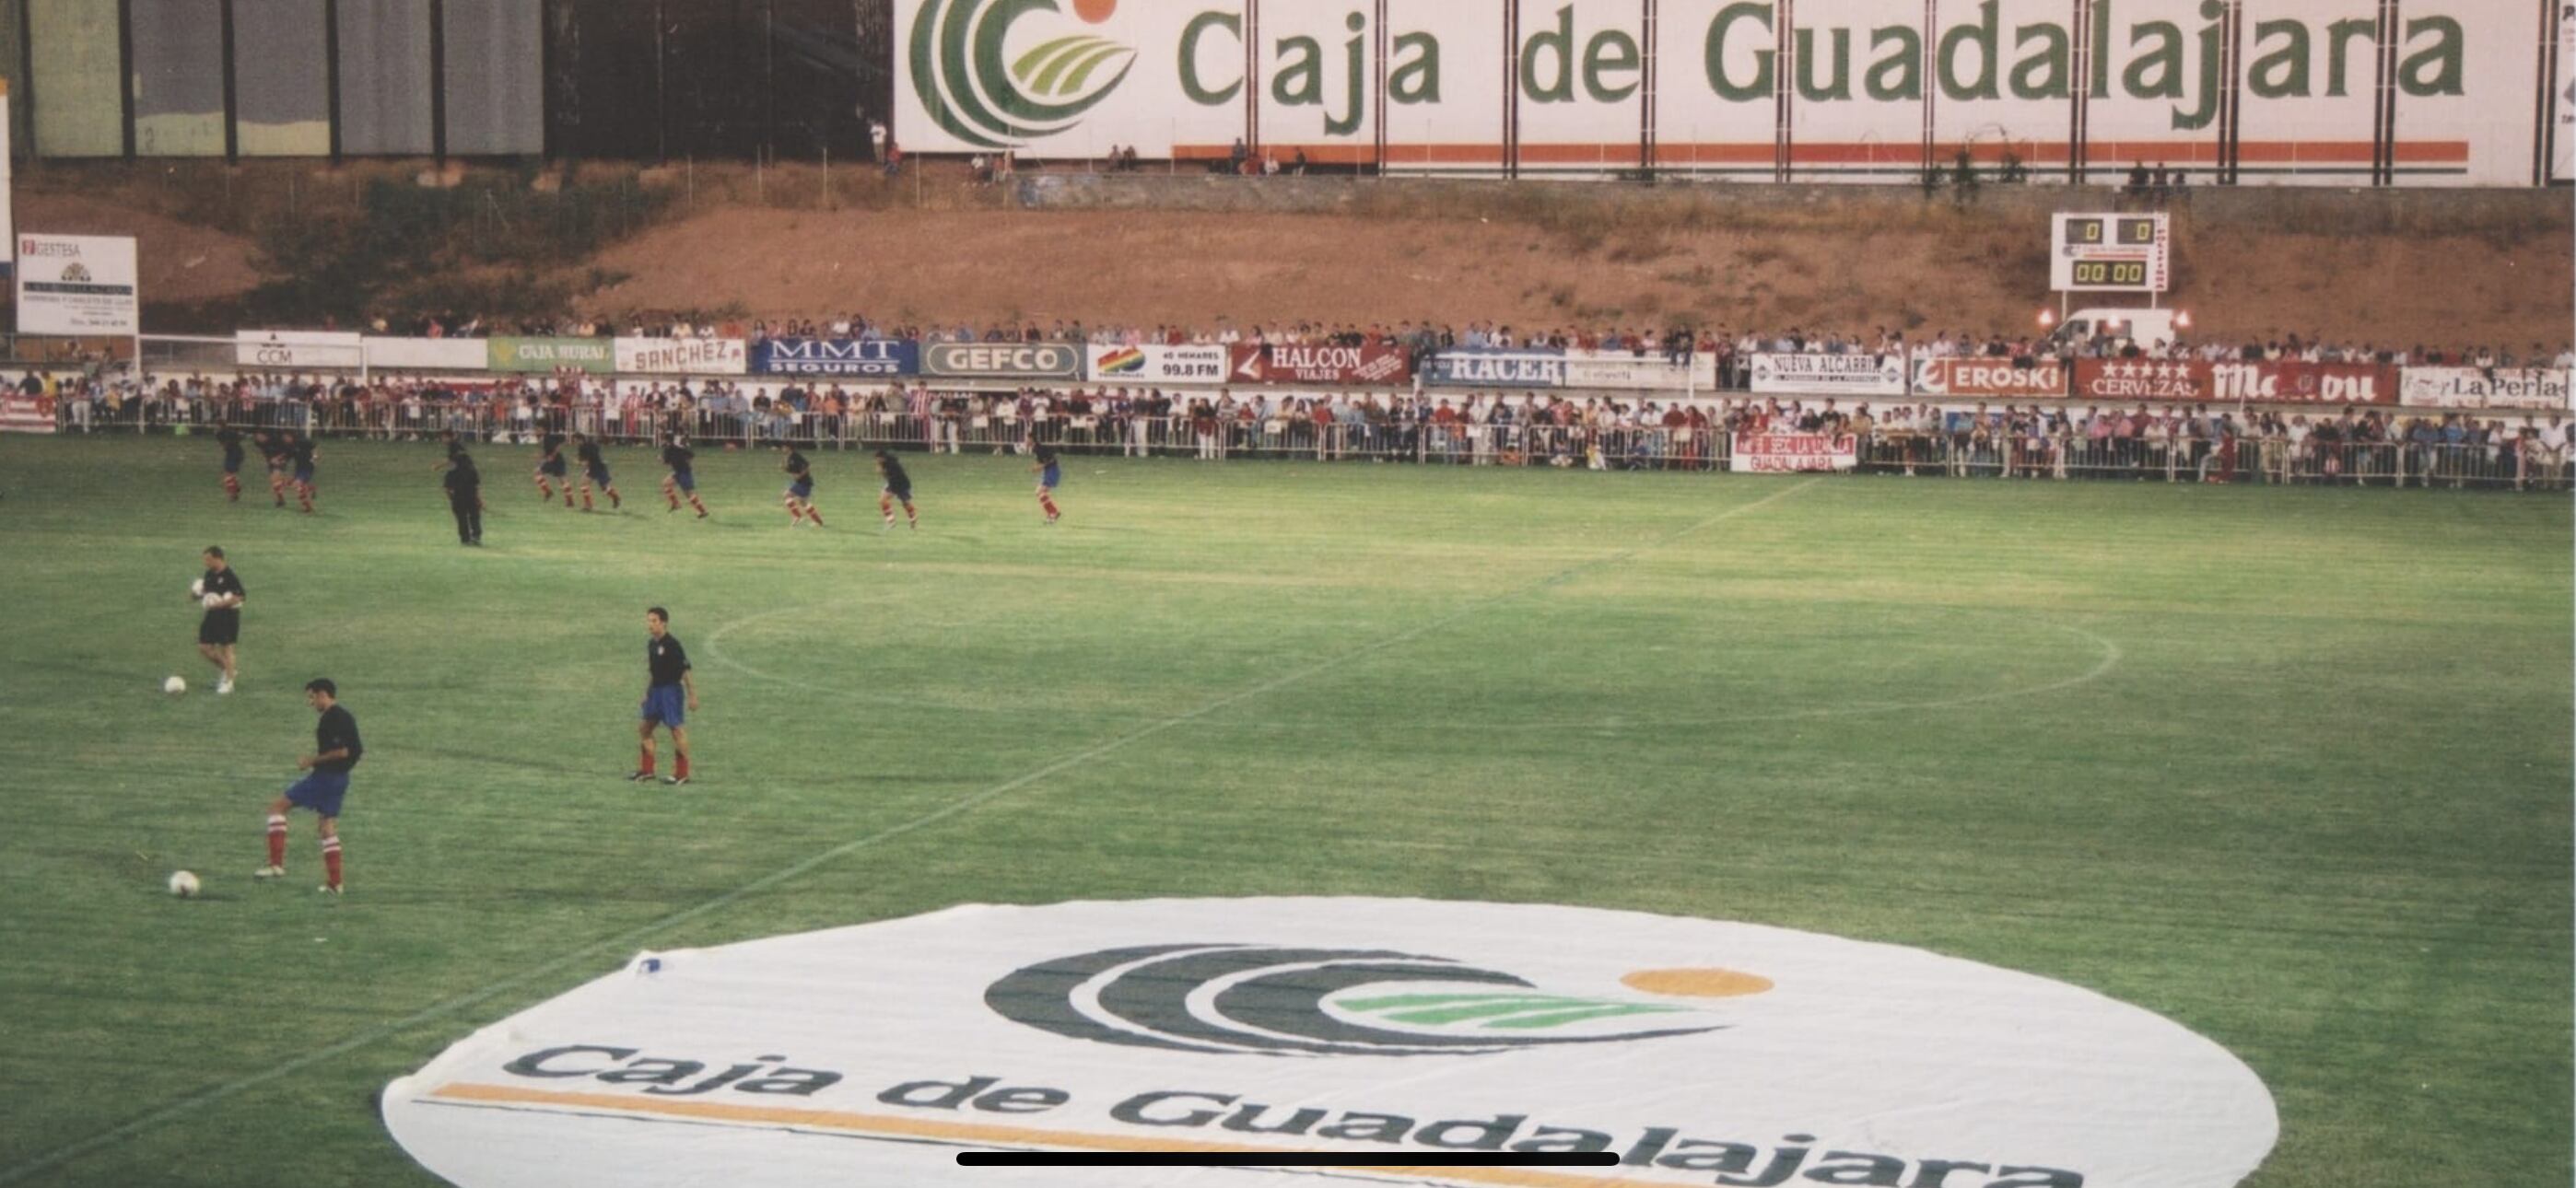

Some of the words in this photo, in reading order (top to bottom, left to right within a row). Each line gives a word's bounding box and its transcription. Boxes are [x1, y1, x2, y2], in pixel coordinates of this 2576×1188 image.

[1177, 11, 1441, 136] Caja
[1520, 5, 1641, 103] de
[1704, 0, 2466, 131] Guadalajara
[2086, 223, 2100, 240] 0
[2137, 223, 2150, 240] 0
[37, 243, 81, 257] GESTESA
[256, 349, 293, 365] CCM
[519, 344, 555, 360] CAJA
[558, 344, 609, 361] RURAL
[635, 341, 728, 369] SANCHEZ
[768, 340, 900, 359] MMT
[1271, 347, 1362, 368] HALCON
[946, 348, 1059, 371] GEFCO
[1774, 356, 1813, 373] NUEVA
[769, 363, 899, 374] SEGUROS
[1162, 364, 1194, 376] 99.8
[1197, 364, 1219, 377] FM
[1295, 368, 1341, 380] VIAJES
[1955, 366, 2058, 390] EROSKI
[2453, 377, 2484, 396] La
[2490, 375, 2558, 397] Perla
[501, 1043, 844, 1096] Caja
[876, 1076, 1071, 1113] de
[1109, 1089, 2087, 1188] Guadalajara
